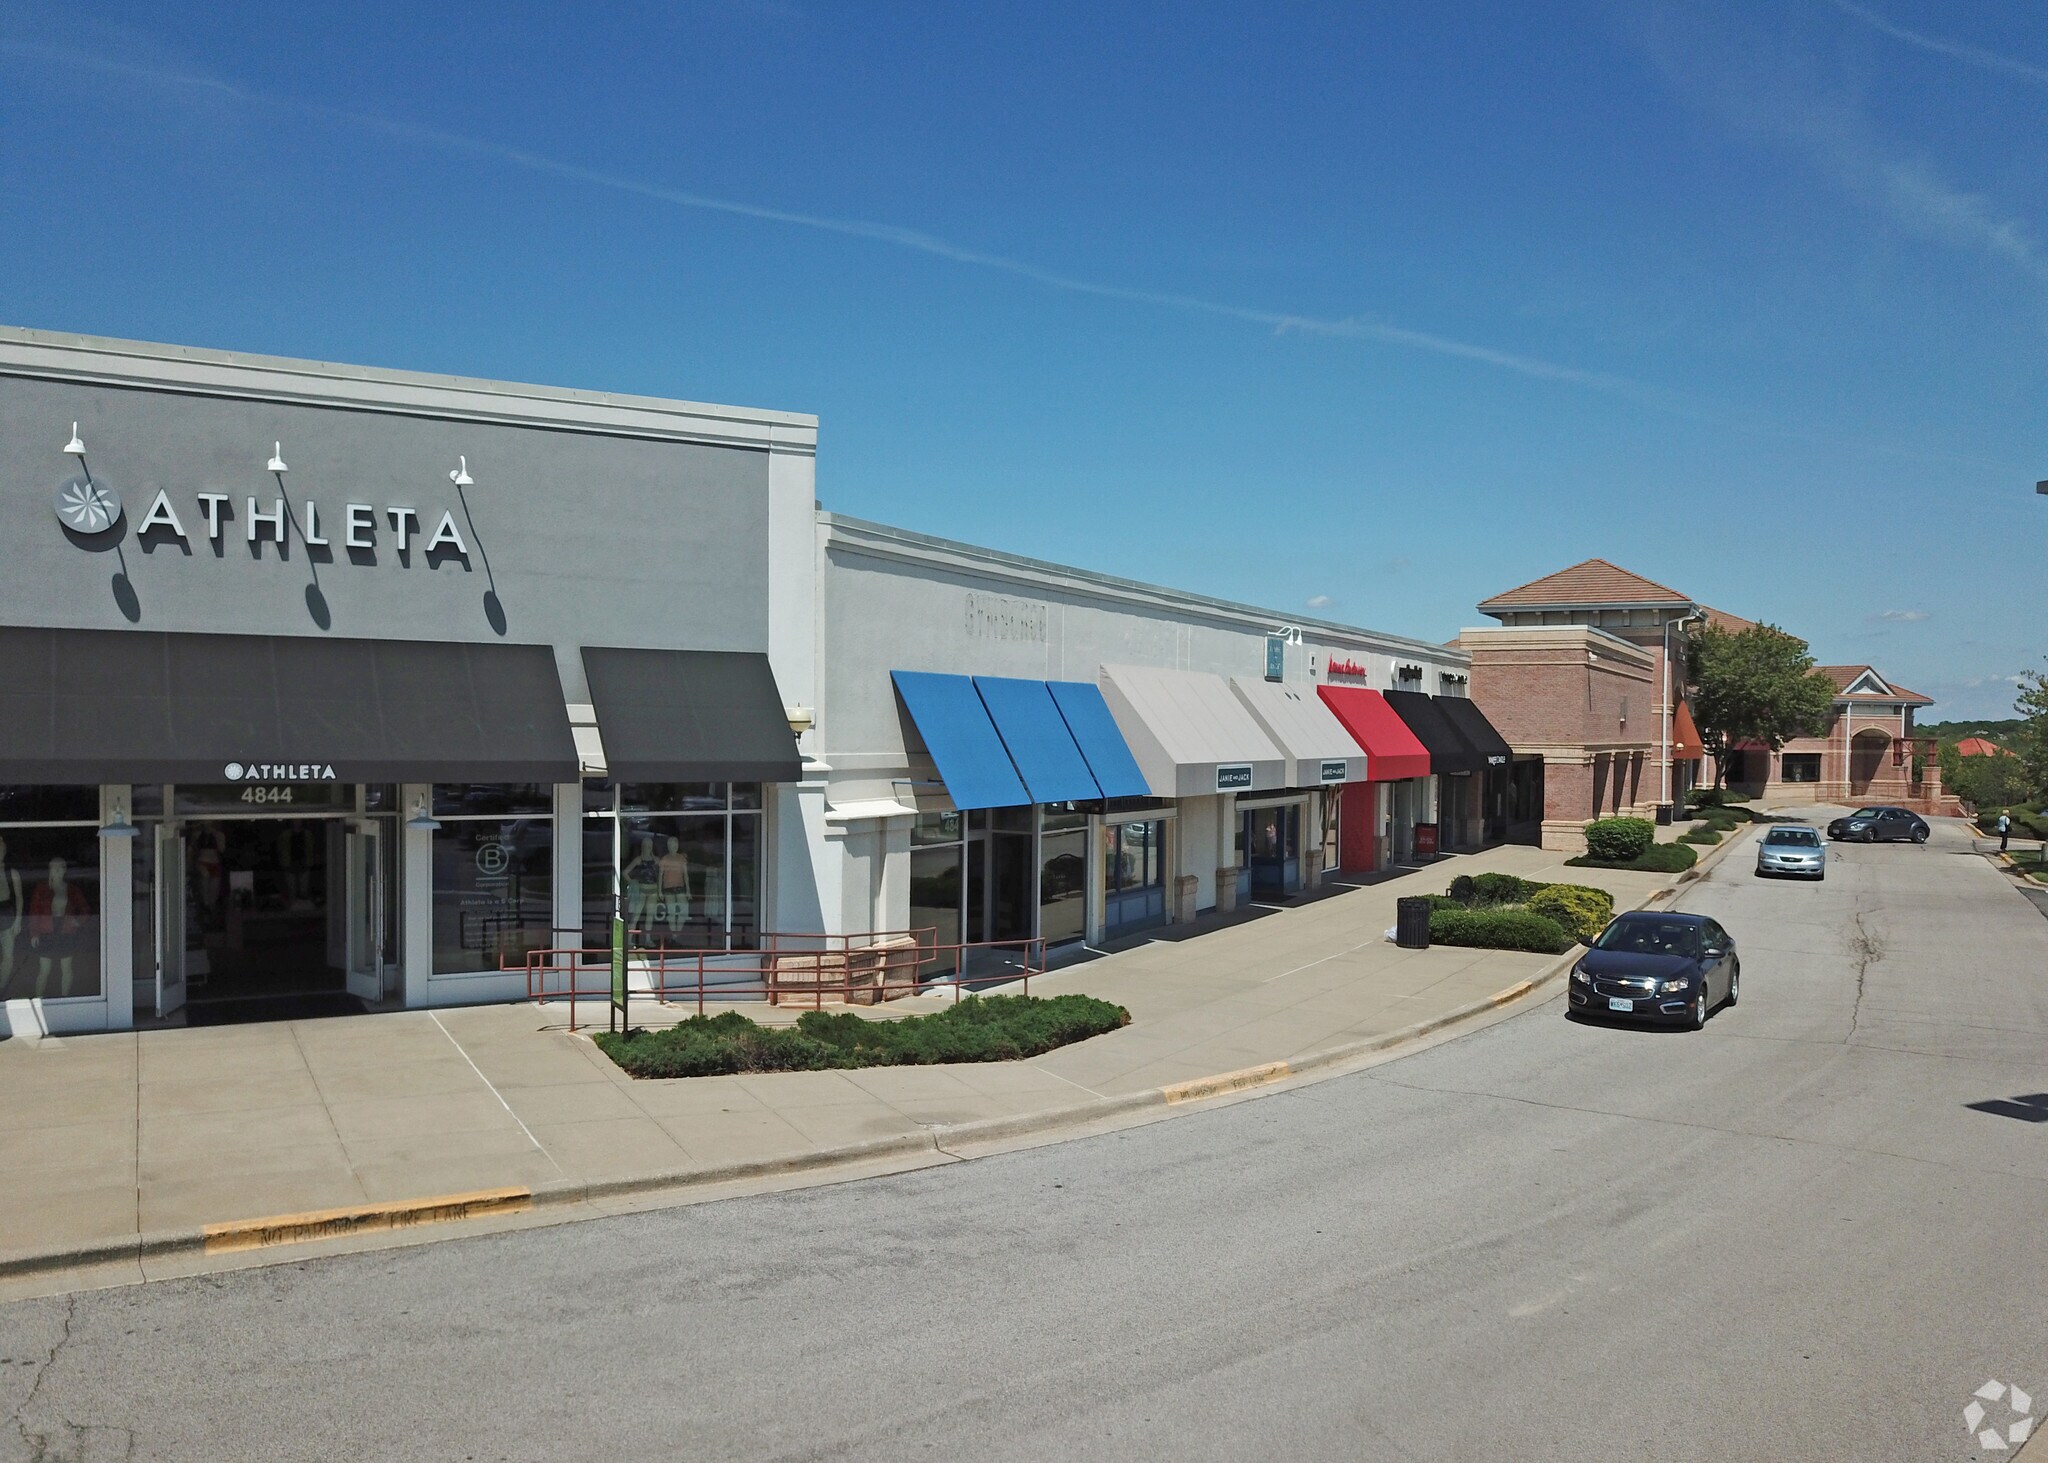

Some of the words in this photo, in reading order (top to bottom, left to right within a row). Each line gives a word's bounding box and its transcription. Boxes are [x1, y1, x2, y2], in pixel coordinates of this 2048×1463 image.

[137, 488, 467, 553] ATHLETA
[245, 764, 336, 780] ATHLETA
[241, 786, 293, 804] 4844
[485, 849, 501, 868] B
[259, 1227, 283, 1246] NO
[433, 1203, 470, 1223] LANE
